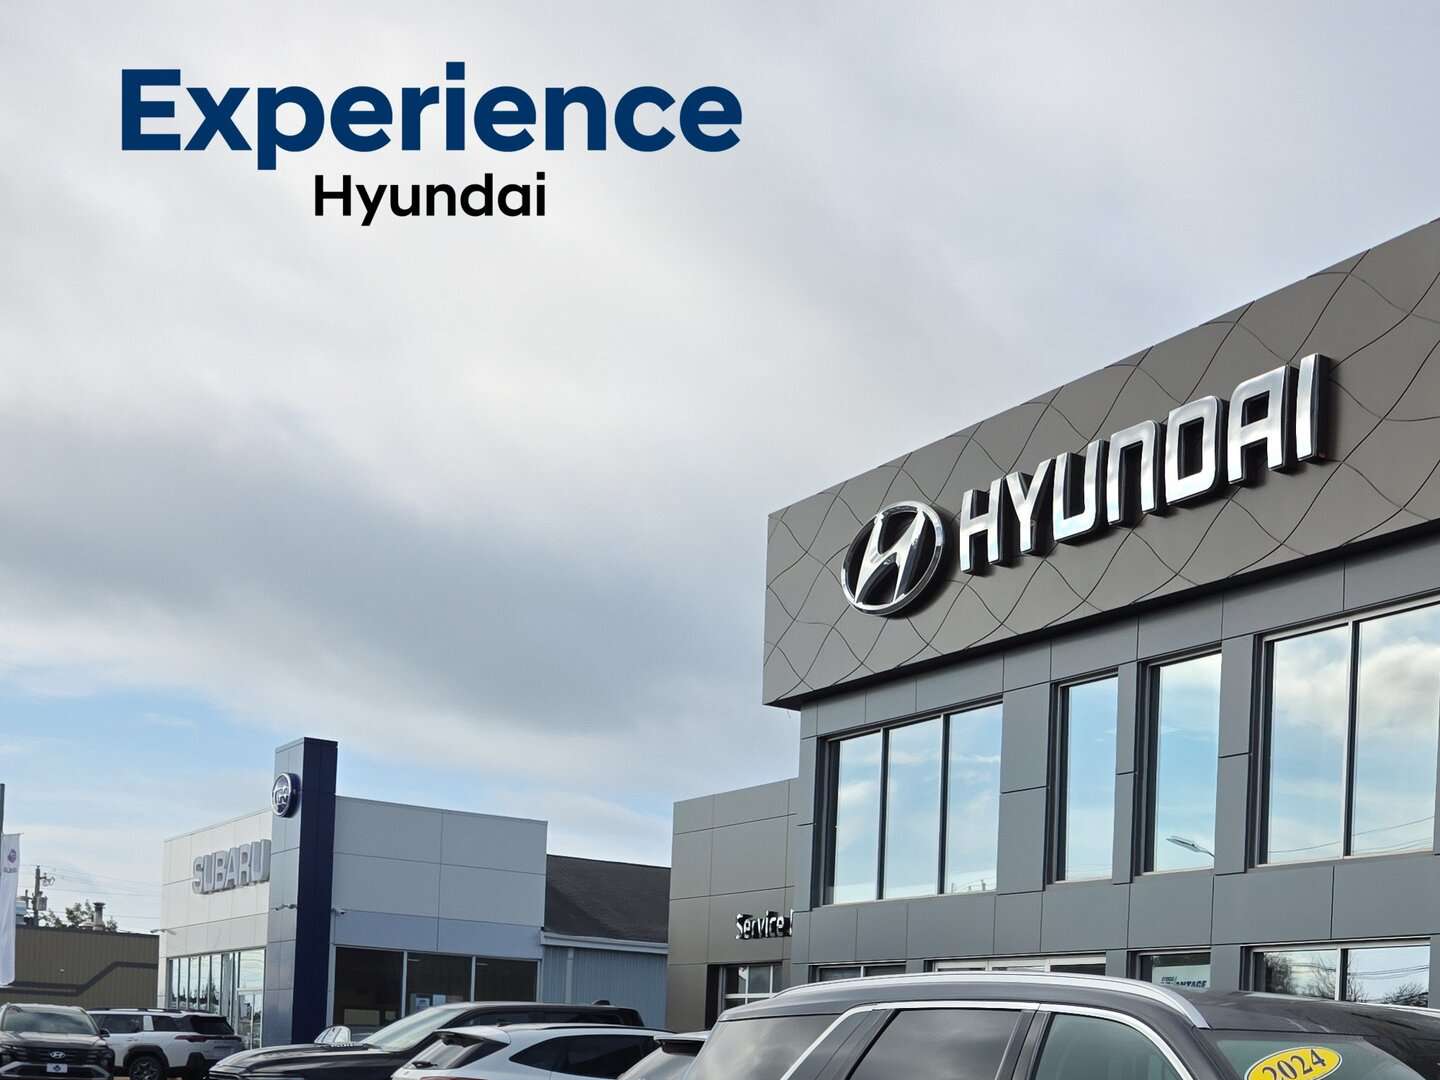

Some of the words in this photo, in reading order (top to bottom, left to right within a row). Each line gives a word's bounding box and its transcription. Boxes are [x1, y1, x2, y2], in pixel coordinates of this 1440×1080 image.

[958, 352, 1325, 574] HYUNDAI
[191, 838, 272, 895] SUBARU
[735, 909, 785, 940] Service
